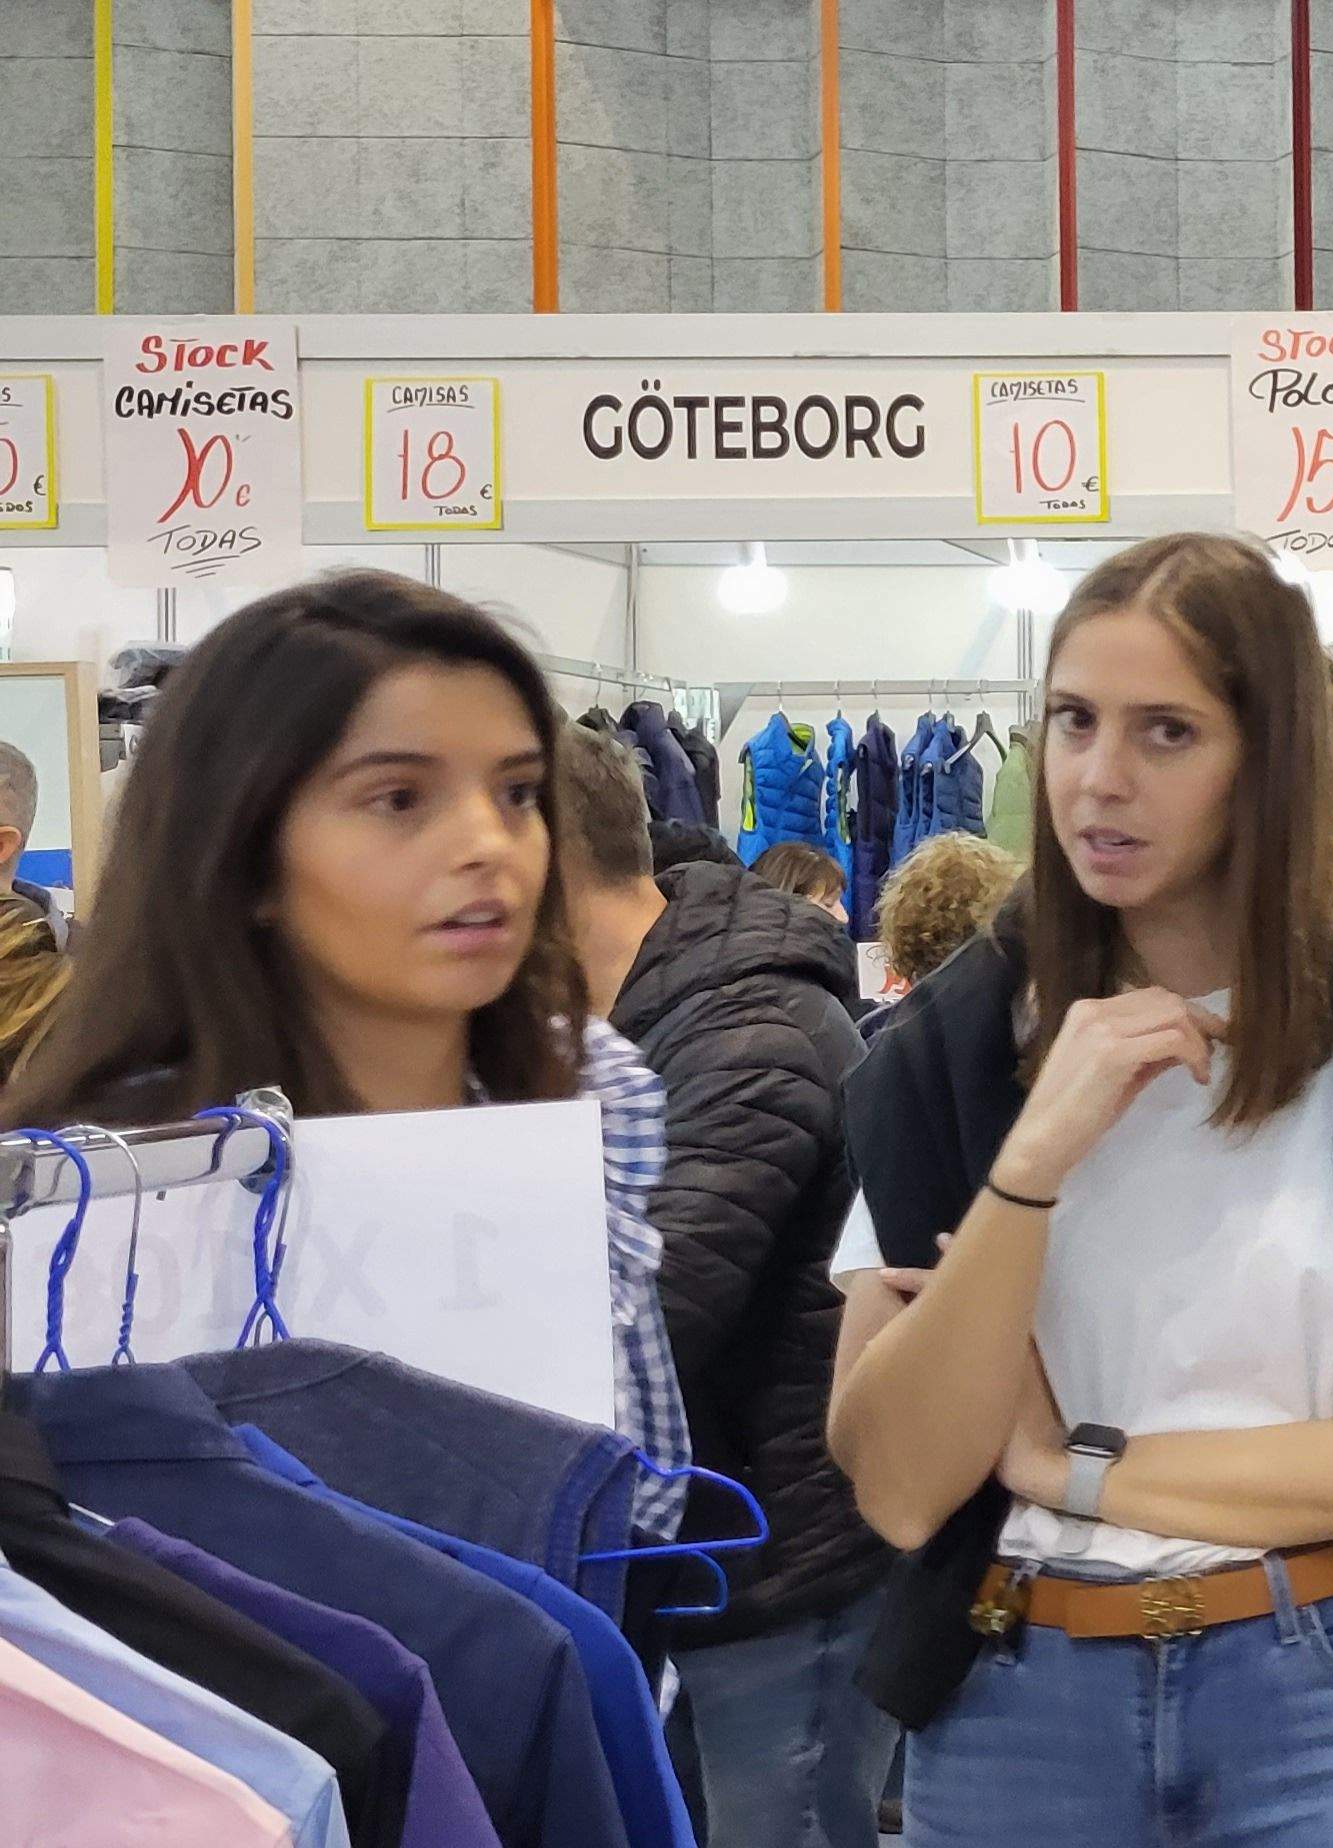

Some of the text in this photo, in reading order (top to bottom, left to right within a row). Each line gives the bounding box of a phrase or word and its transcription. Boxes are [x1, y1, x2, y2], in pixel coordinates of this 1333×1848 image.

[135, 334, 275, 373] STOCK
[115, 381, 294, 420] CAMiSETAS
[391, 386, 469, 407] CAMISAS
[991, 378, 1078, 401] CAMISETAS
[583, 379, 925, 459] GÖTEBORG
[433, 506, 478, 516] TODAS
[149, 526, 264, 554] TODAS
